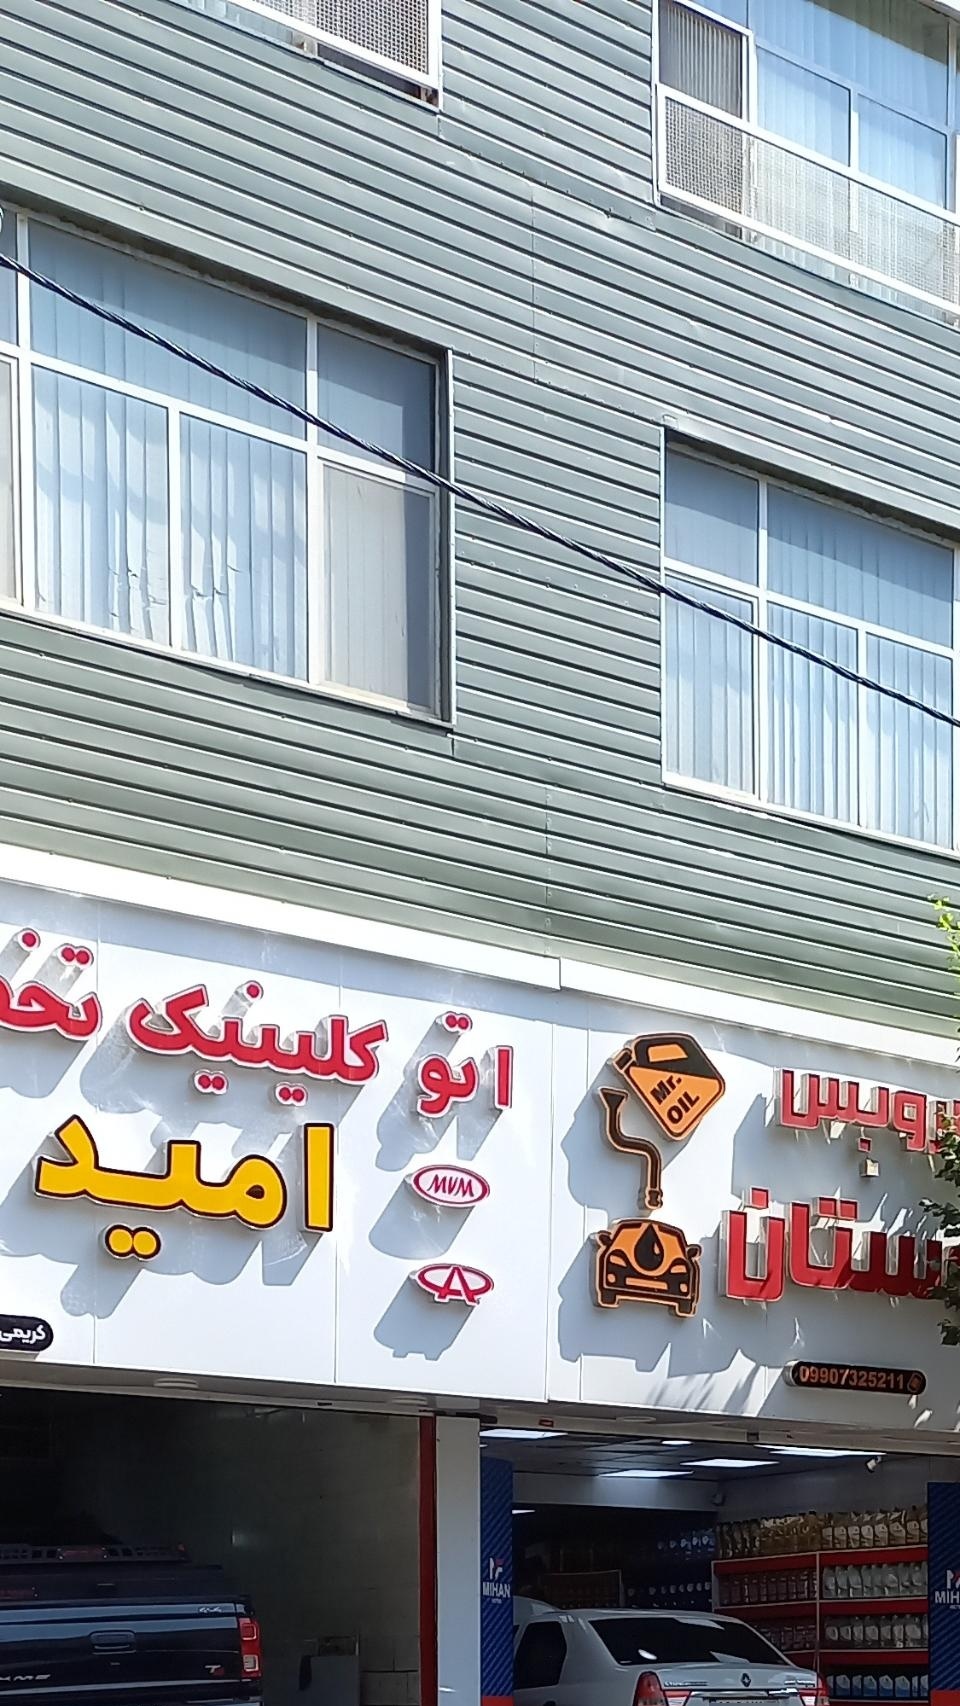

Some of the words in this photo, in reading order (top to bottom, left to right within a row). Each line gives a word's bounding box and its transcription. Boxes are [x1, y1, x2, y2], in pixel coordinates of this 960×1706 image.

[128, 983, 388, 1105] کلینیک
[416, 1012, 513, 1116] اتو
[650, 1075, 682, 1105] Mr.
[667, 1091, 700, 1125] OIL
[36, 1115, 335, 1260] امید
[426, 1173, 475, 1198] MVM
[0, 1324, 46, 1344] کریمی
[799, 1364, 904, 1390] 09907325211
[482, 1581, 511, 1598] MIHAN
